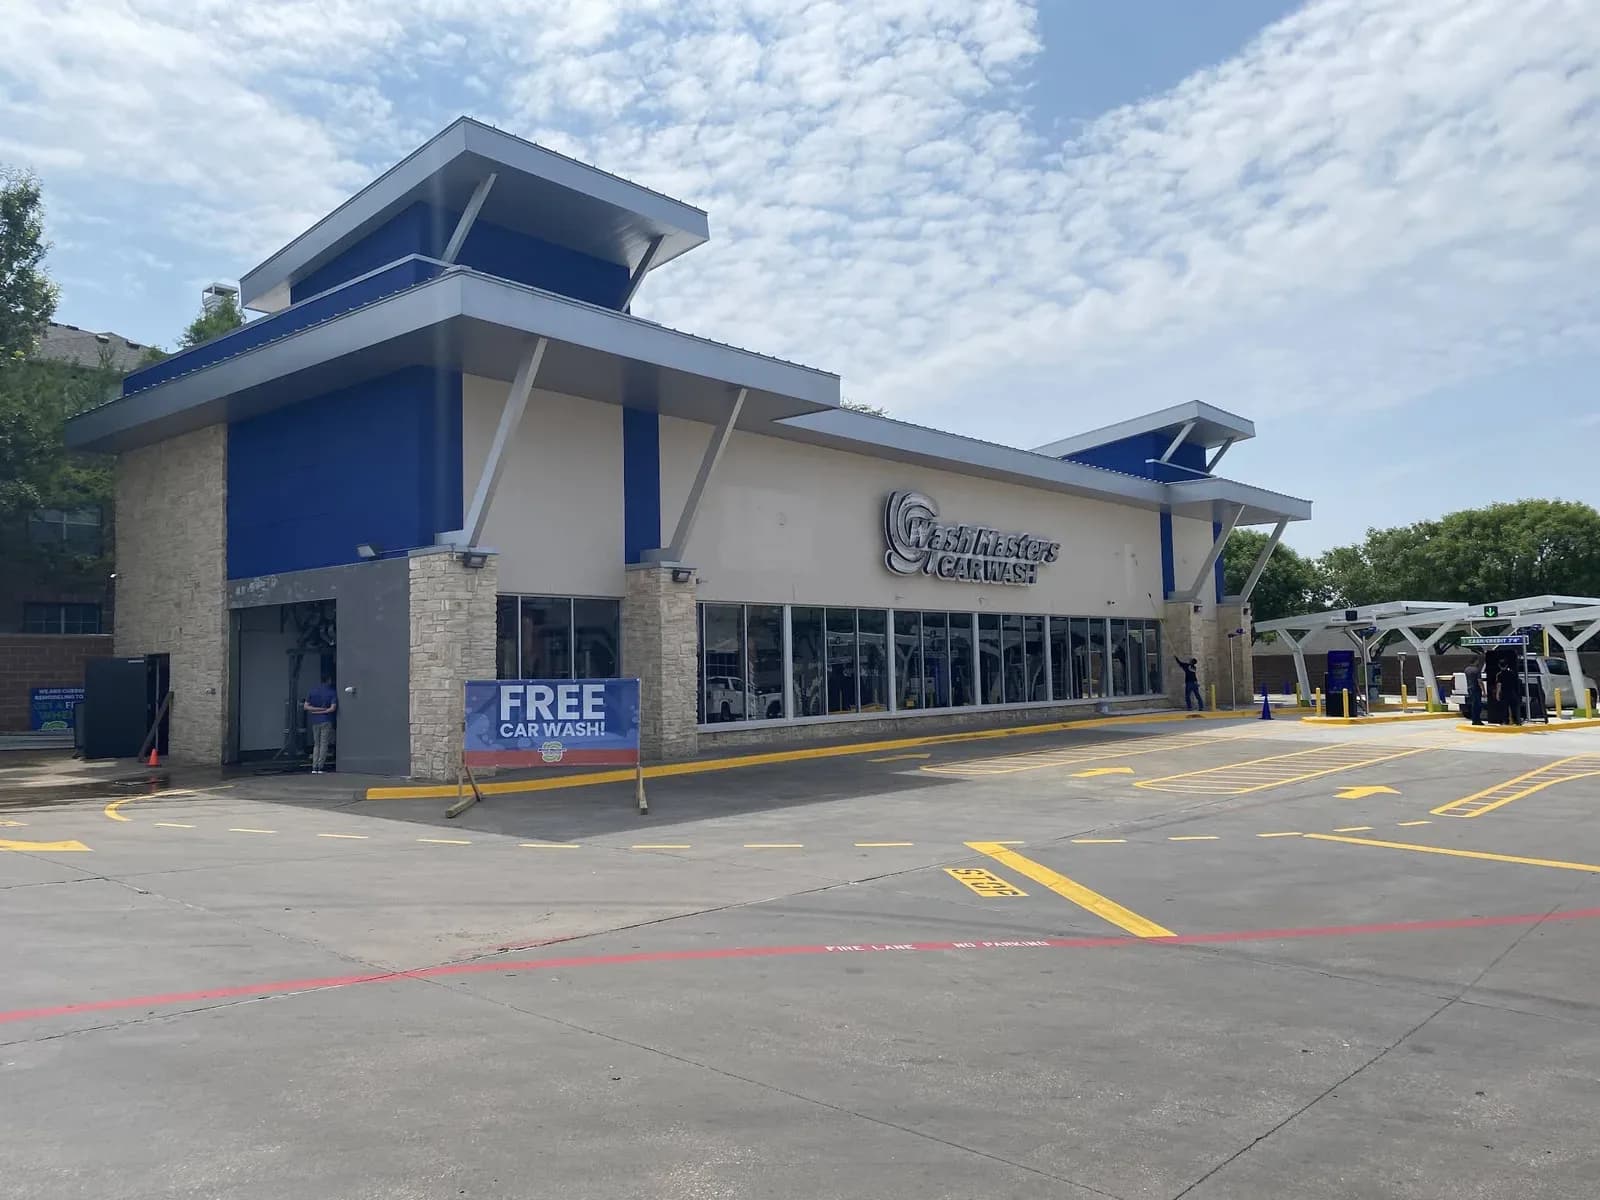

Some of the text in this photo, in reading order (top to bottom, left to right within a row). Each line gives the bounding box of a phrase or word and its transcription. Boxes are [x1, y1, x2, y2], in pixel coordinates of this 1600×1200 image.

[908, 519, 1061, 562] Wash Masters
[938, 555, 1038, 584] CAR WASH
[500, 684, 605, 721] FREE
[500, 721, 606, 738] CAR WASH!
[951, 869, 1020, 896] STOP
